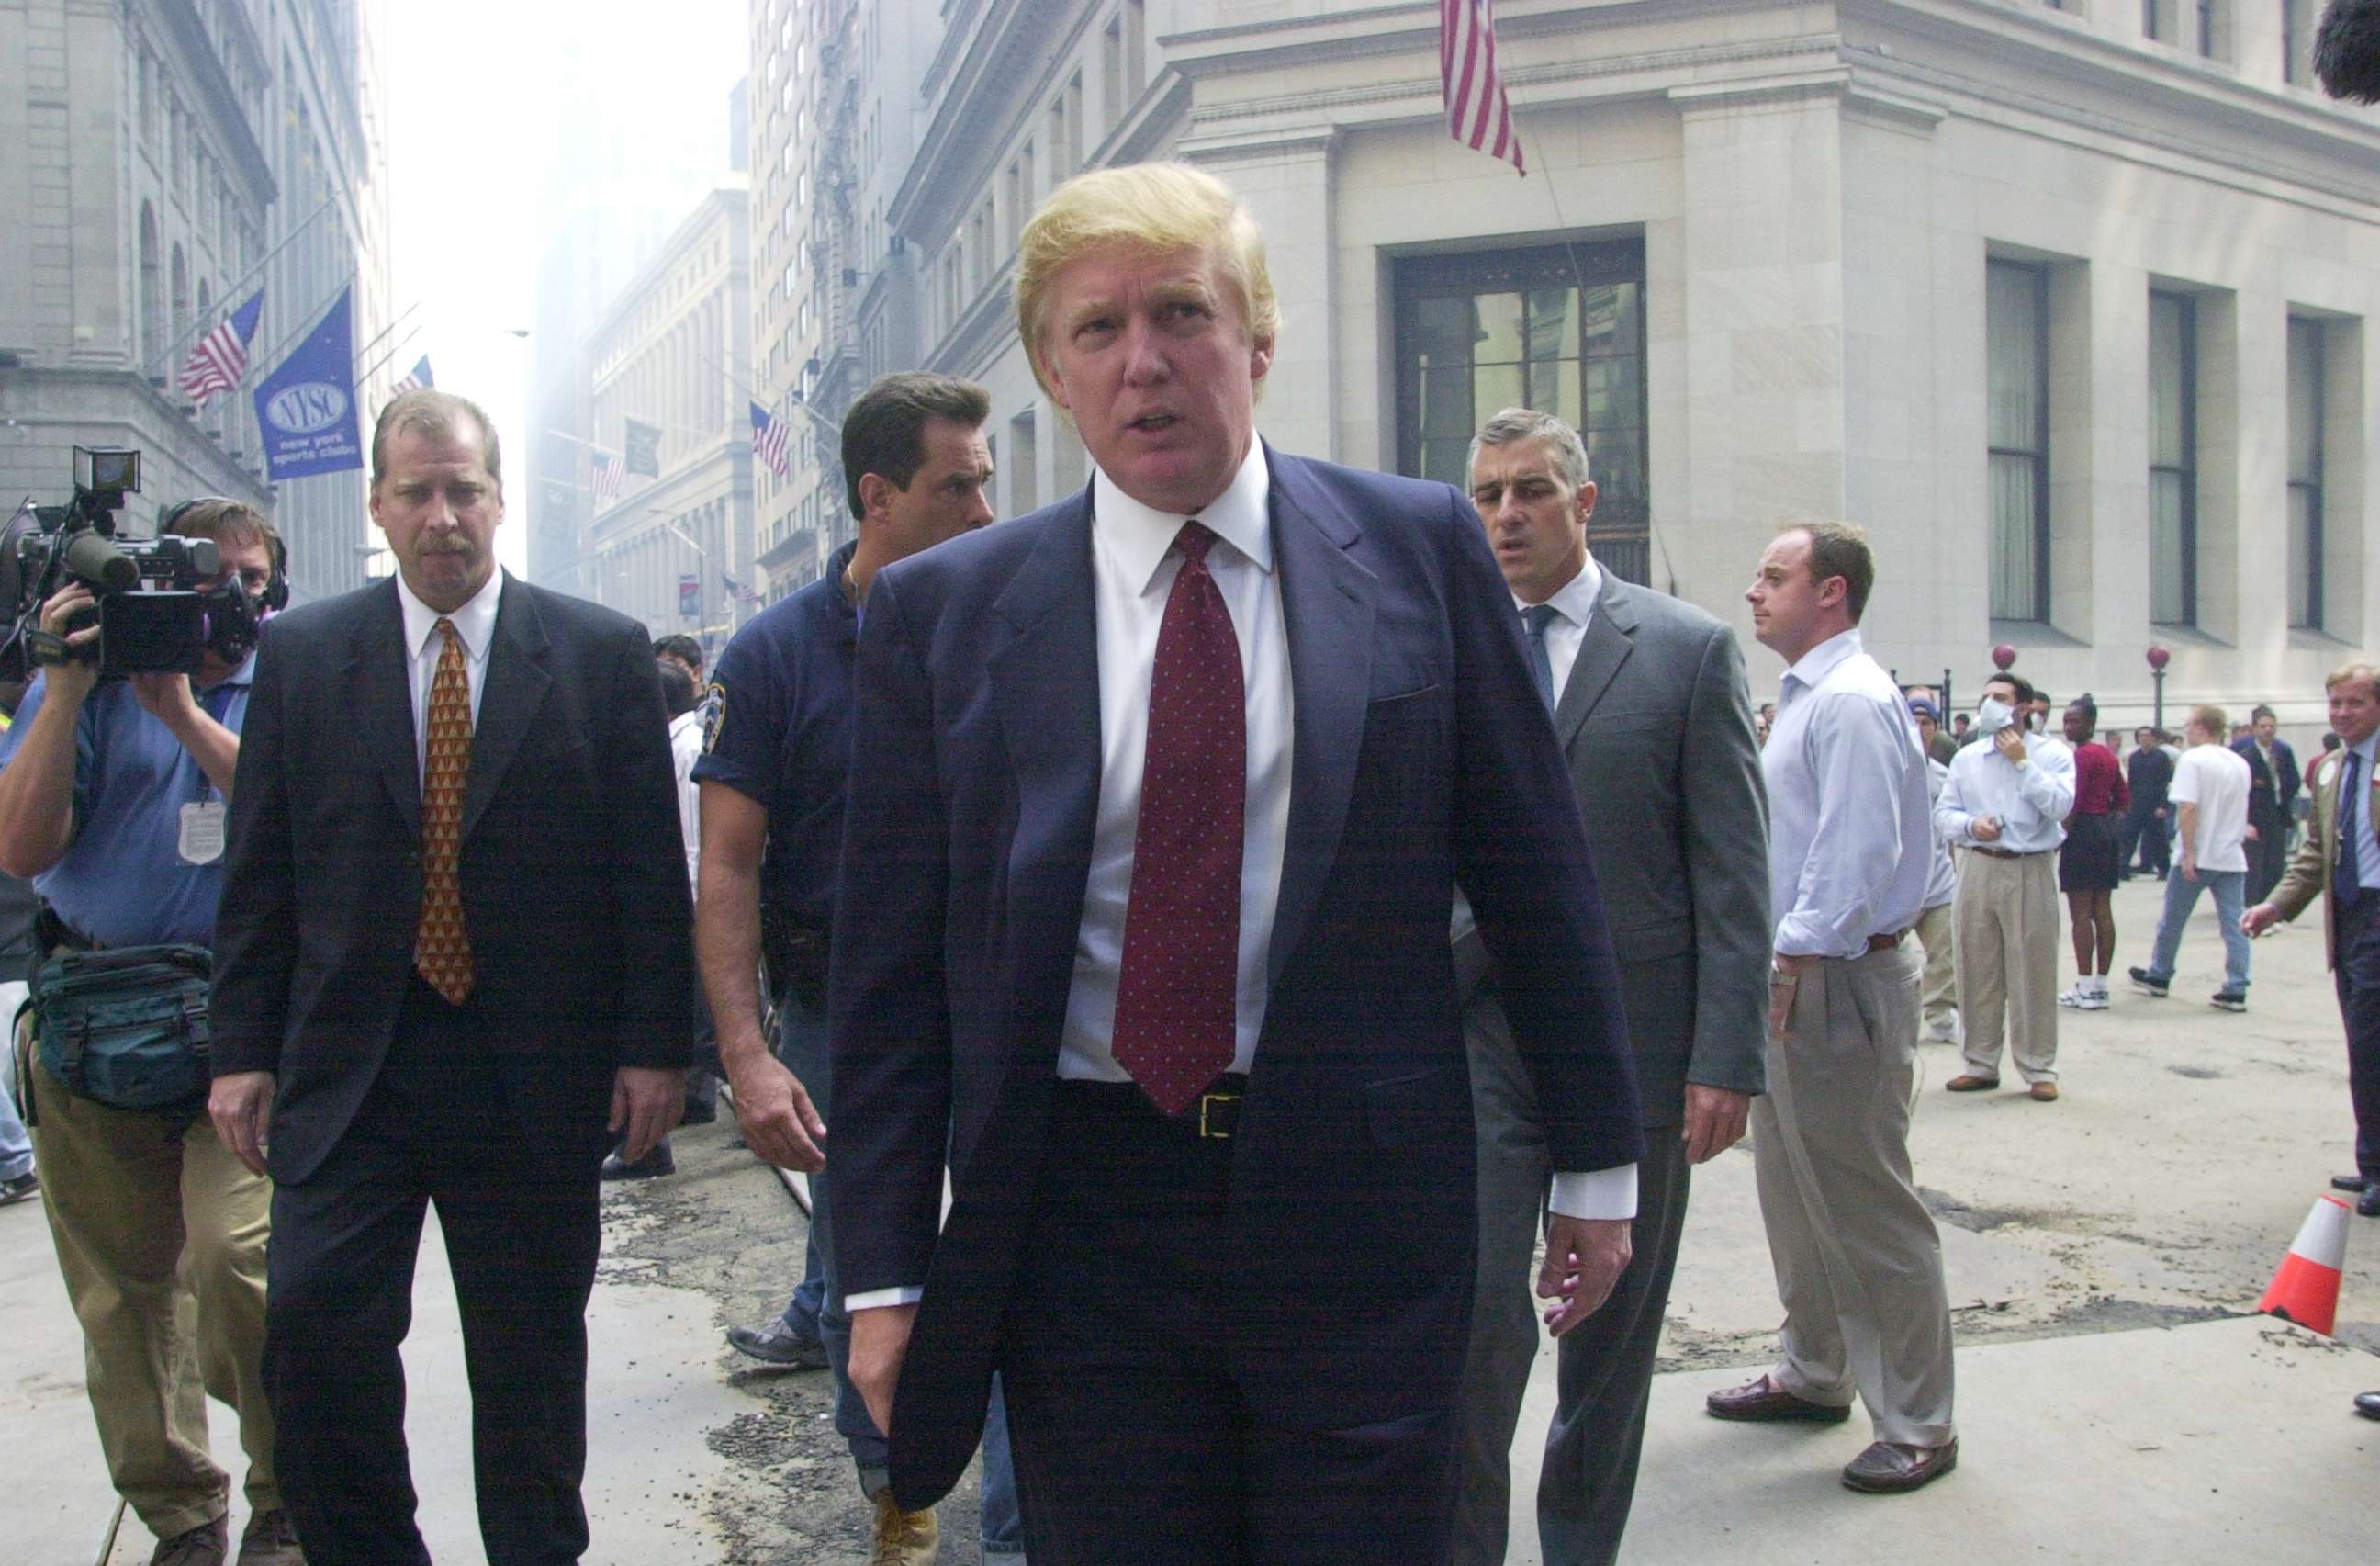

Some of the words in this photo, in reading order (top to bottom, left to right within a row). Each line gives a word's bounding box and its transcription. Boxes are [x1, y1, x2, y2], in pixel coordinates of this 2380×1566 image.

[279, 386, 336, 427] NYSC
[279, 438, 309, 451] new
[313, 432, 344, 450] york
[273, 450, 317, 467] sports
[319, 444, 357, 457] clubs
